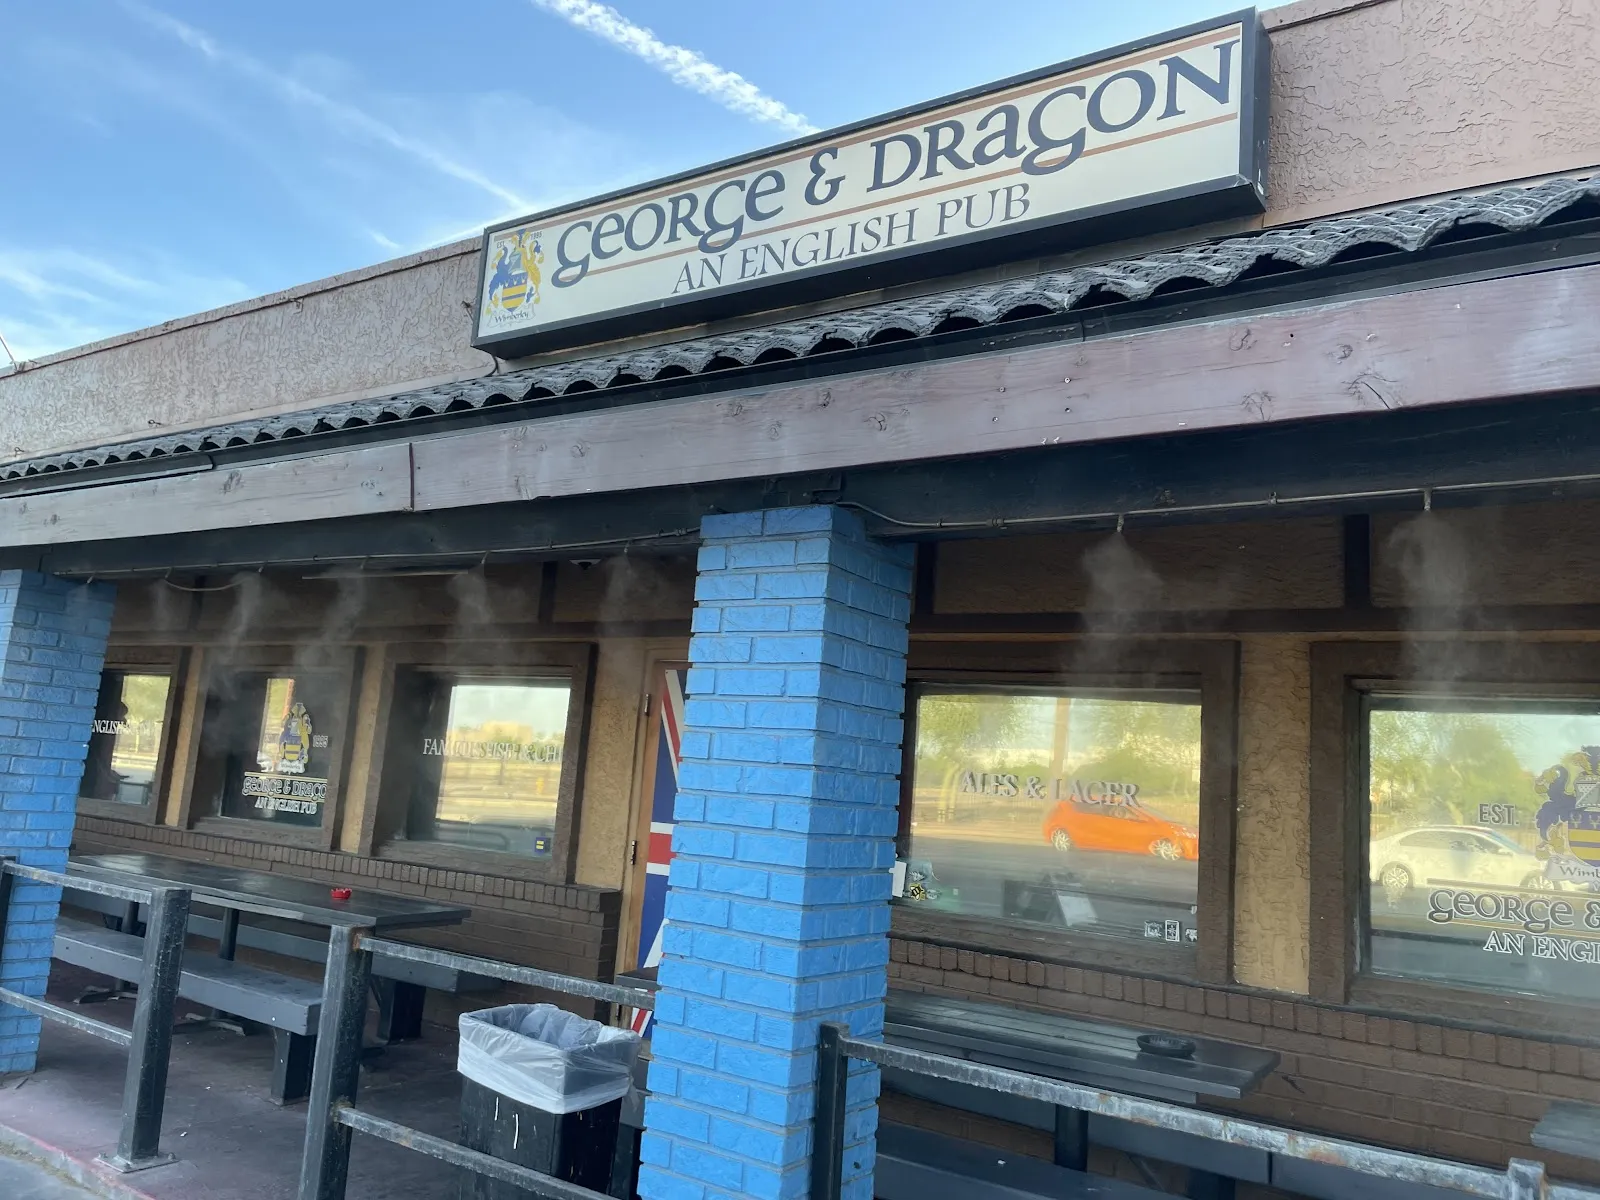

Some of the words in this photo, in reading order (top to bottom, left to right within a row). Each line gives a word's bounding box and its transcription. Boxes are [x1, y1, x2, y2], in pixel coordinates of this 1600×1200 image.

[805, 147, 846, 205] &
[671, 253, 726, 294] AN
[737, 208, 919, 281] ENGLISH
[935, 183, 1030, 237] PUB
[283, 779, 291, 794] &
[960, 768, 1019, 797] ALES
[1025, 775, 1046, 799] &
[255, 797, 267, 809] AN
[301, 801, 317, 814] PUB
[1479, 804, 1519, 825] EST.
[1483, 930, 1525, 956] AN
